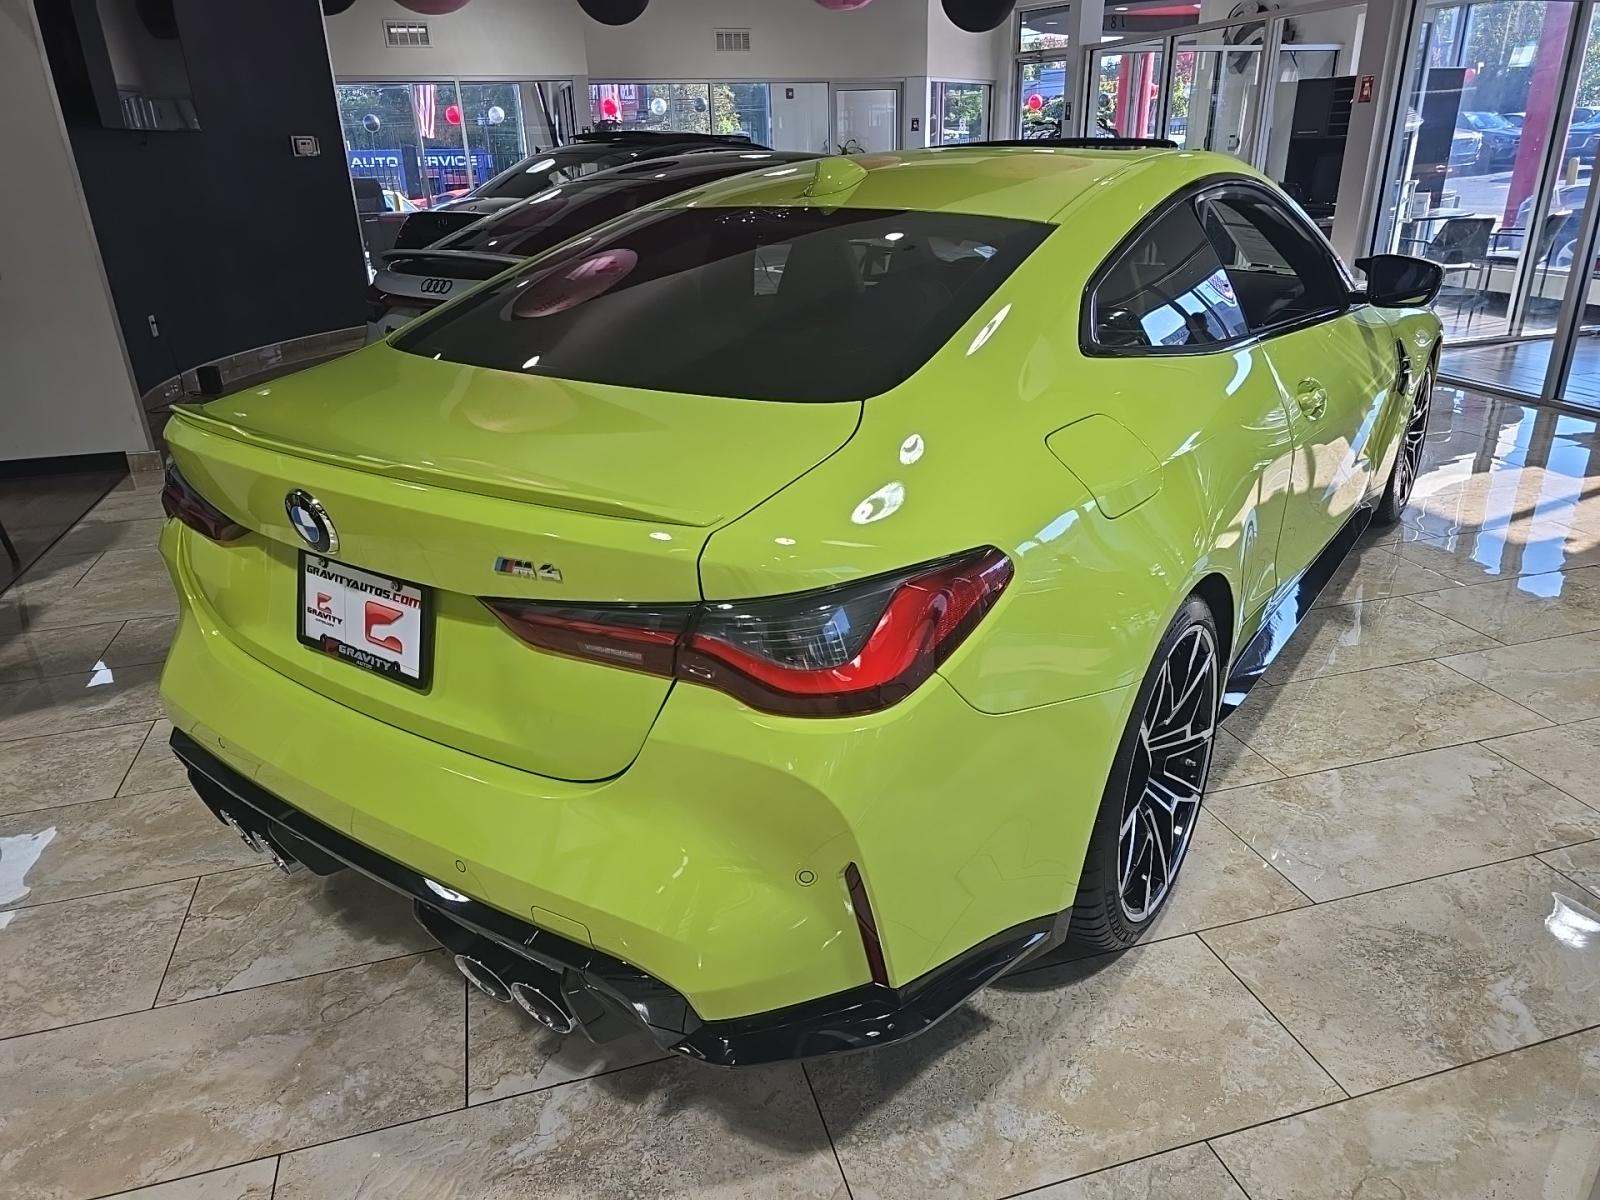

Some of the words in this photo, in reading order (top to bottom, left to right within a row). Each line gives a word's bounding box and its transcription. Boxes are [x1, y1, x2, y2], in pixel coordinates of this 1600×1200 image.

[351, 156, 398, 168] AUTO
[417, 155, 478, 167] ERVICE
[500, 557, 563, 583] M4
[307, 606, 343, 625] GRAVITY
[338, 644, 391, 671] GRAVITY
